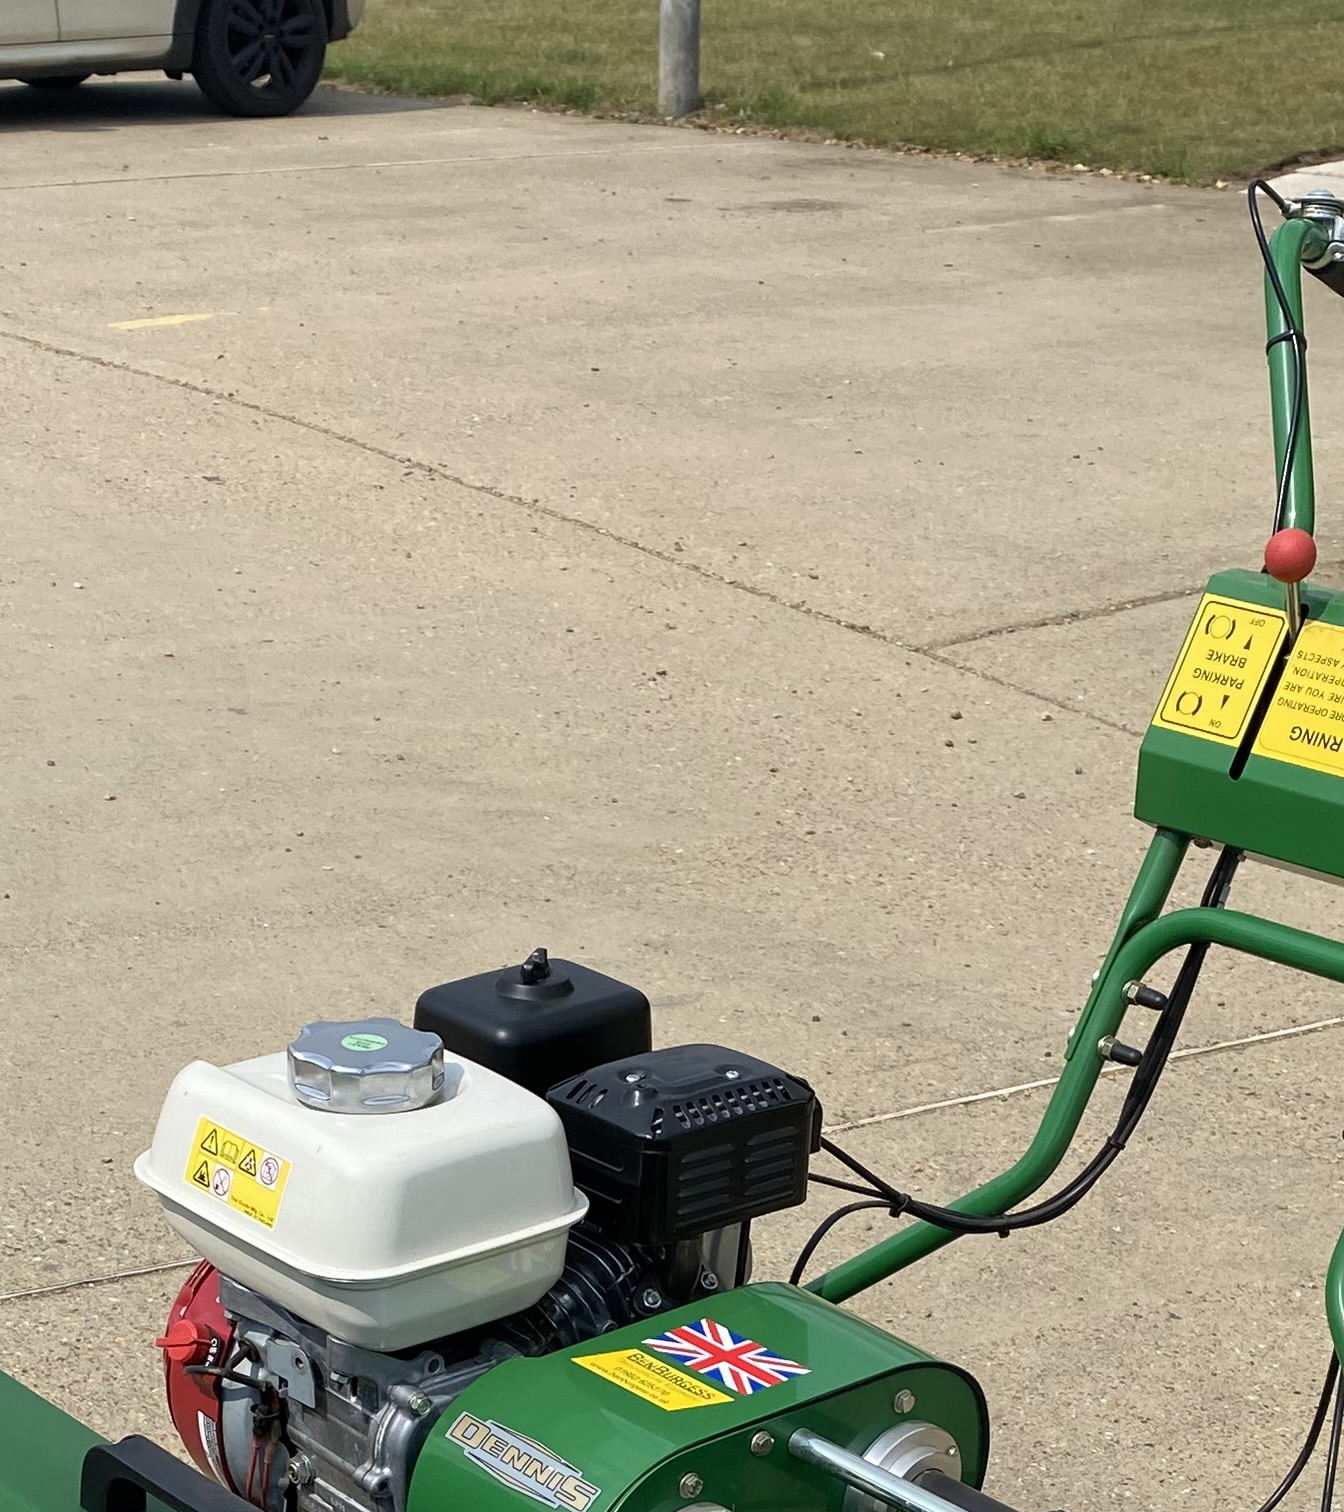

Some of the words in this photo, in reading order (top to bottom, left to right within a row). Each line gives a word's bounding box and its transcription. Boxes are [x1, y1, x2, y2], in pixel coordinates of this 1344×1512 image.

[1249, 617, 1266, 627] OFF
[1205, 649, 1248, 669] BRAKE
[1297, 650, 1341, 668] ASPECTS
[1192, 667, 1246, 690] PARKING
[1283, 681, 1303, 694] ARE
[1306, 687, 1325, 701] YOU
[1277, 697, 1328, 717] OPERATING
[1208, 718, 1222, 729] ON
[450, 1414, 599, 1512] DENNIS
